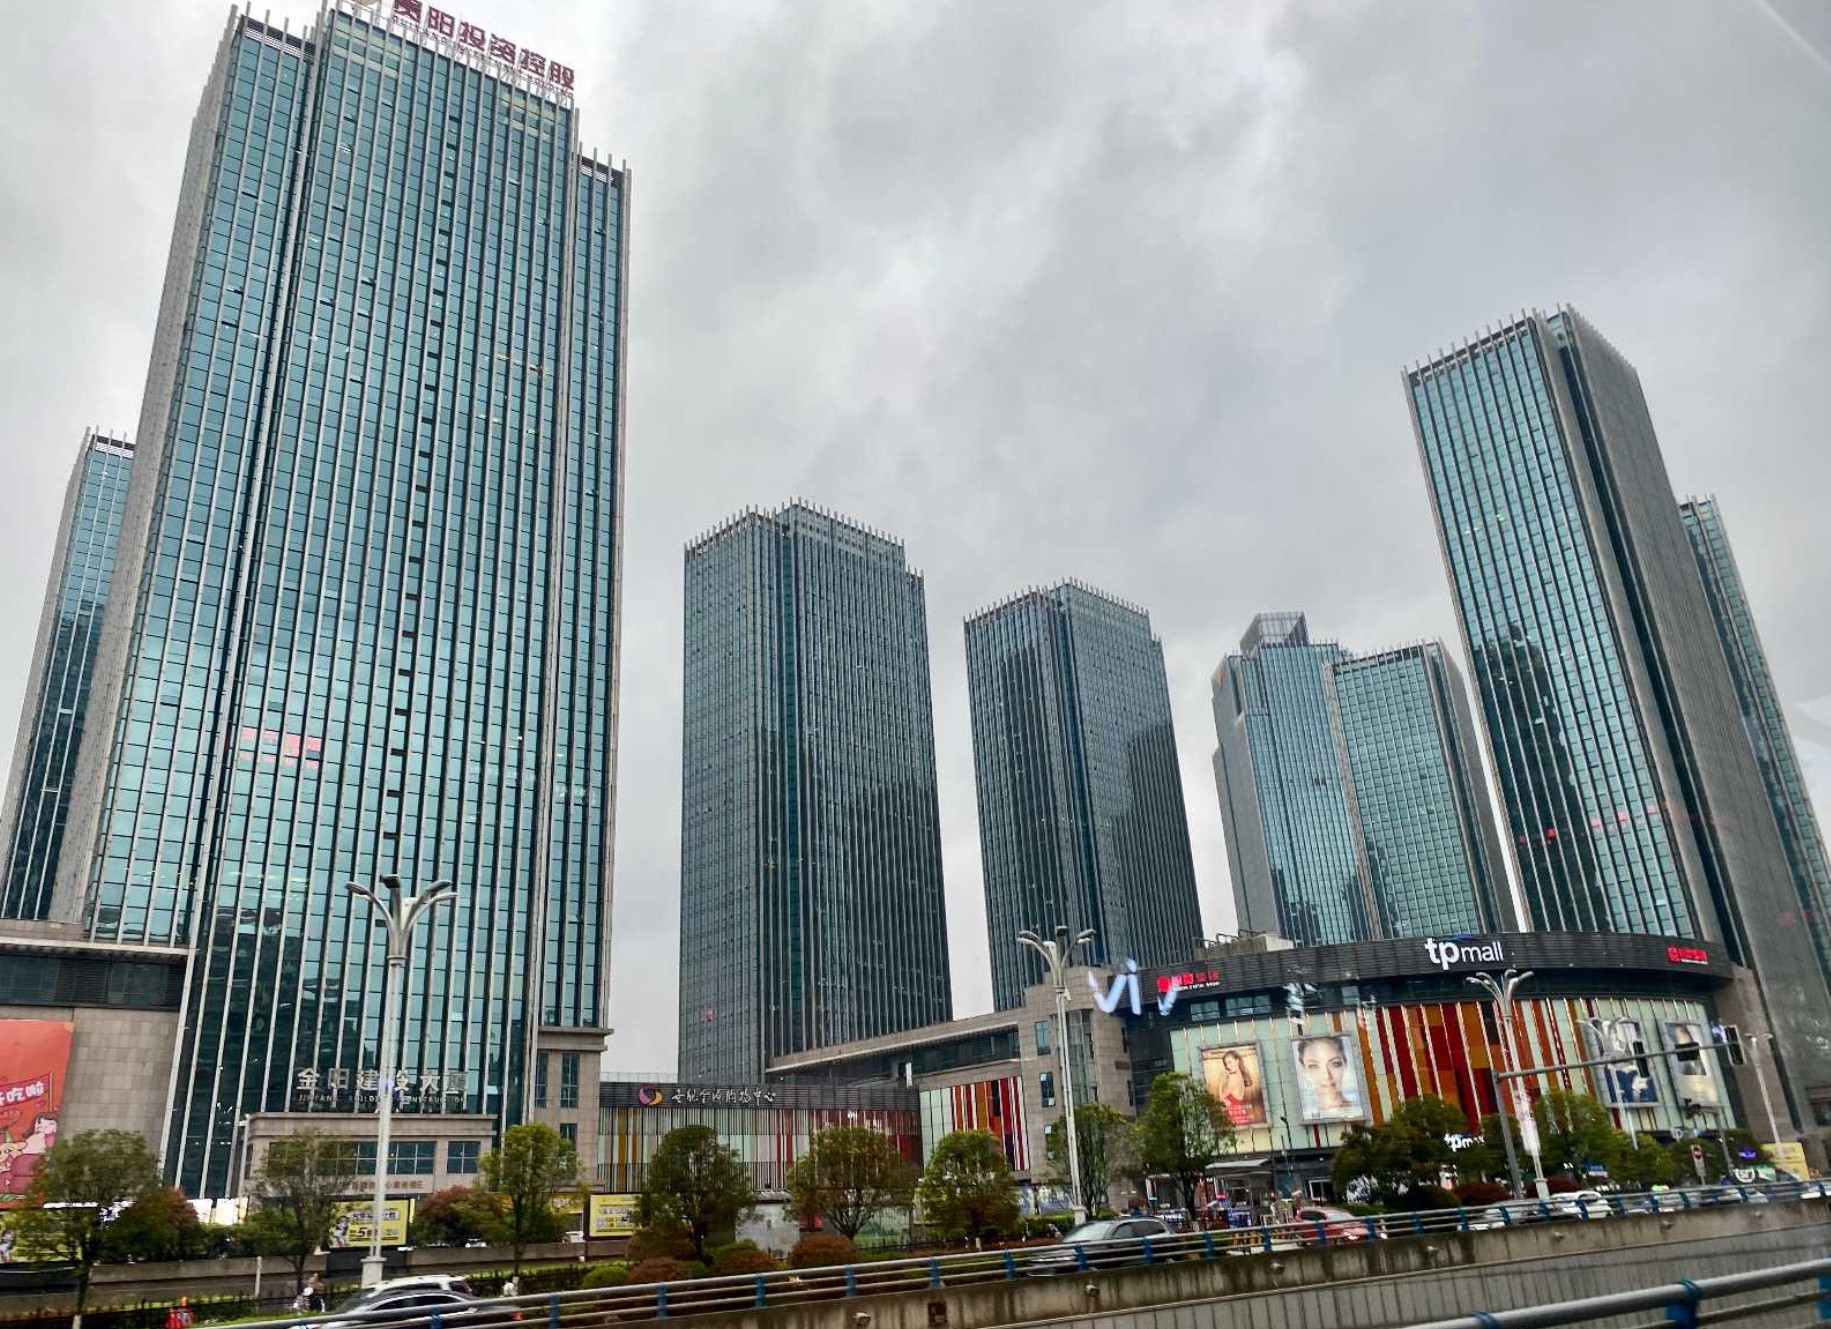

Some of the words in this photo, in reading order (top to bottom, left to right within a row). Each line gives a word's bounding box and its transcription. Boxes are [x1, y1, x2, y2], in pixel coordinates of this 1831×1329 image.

[296, 1067, 468, 1094] 金阳建设大厦
